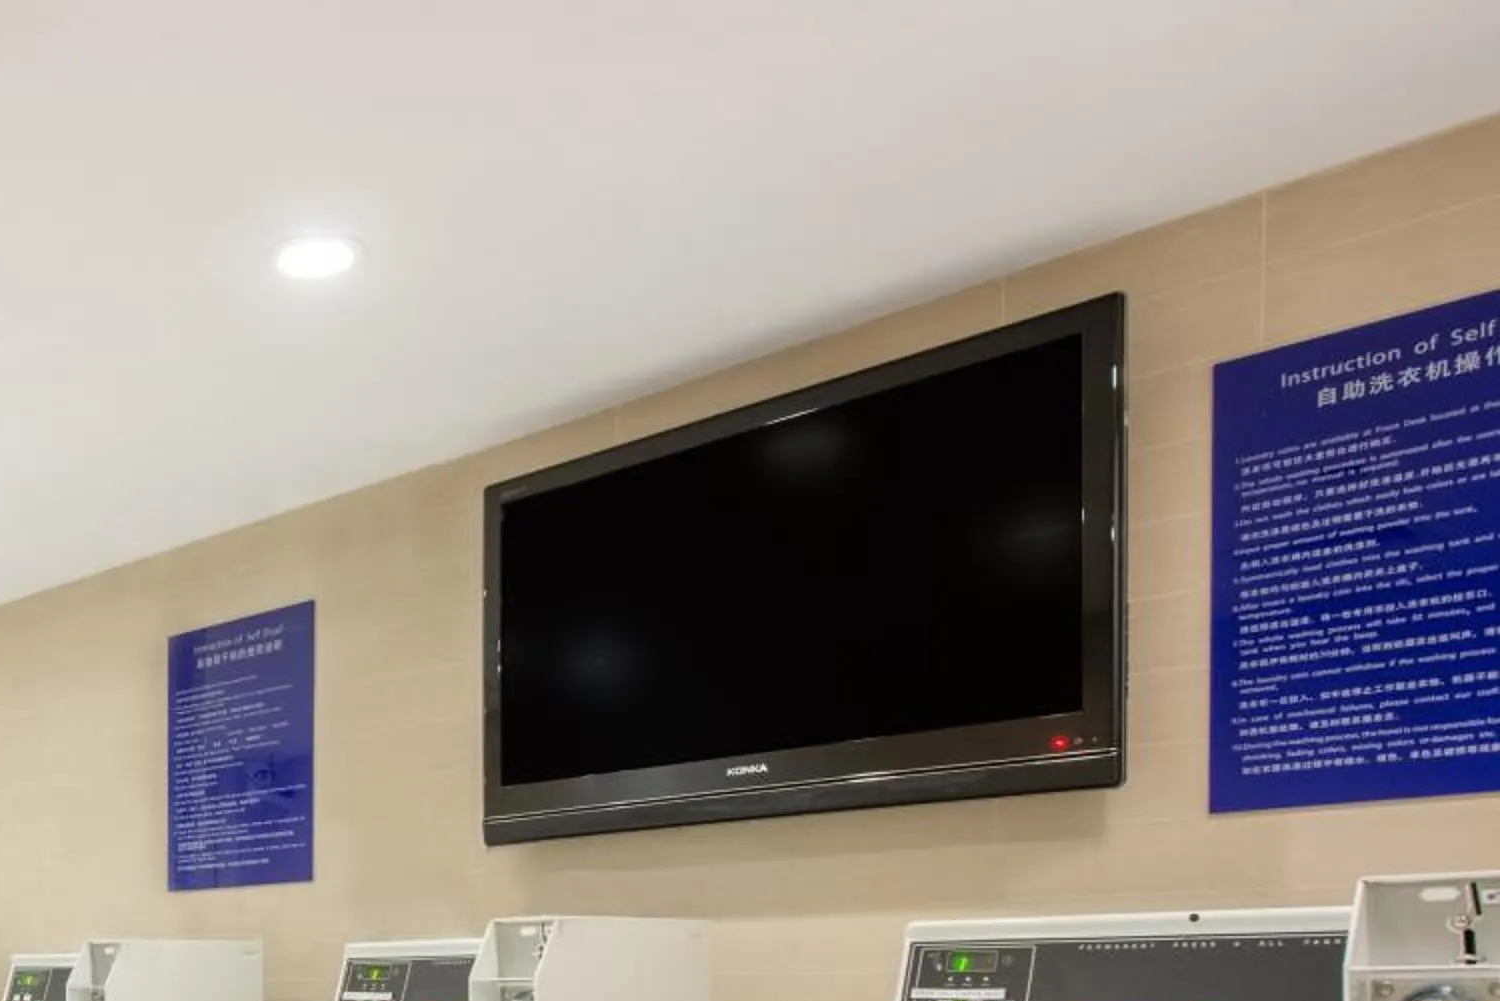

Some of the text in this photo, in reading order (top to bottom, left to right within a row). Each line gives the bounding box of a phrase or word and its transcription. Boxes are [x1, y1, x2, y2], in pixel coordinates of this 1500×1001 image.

[1280, 319, 1497, 388] Instruction of Self
[1316, 344, 1500, 408] 自助洗衣机操作
[725, 762, 769, 777] KONKA
